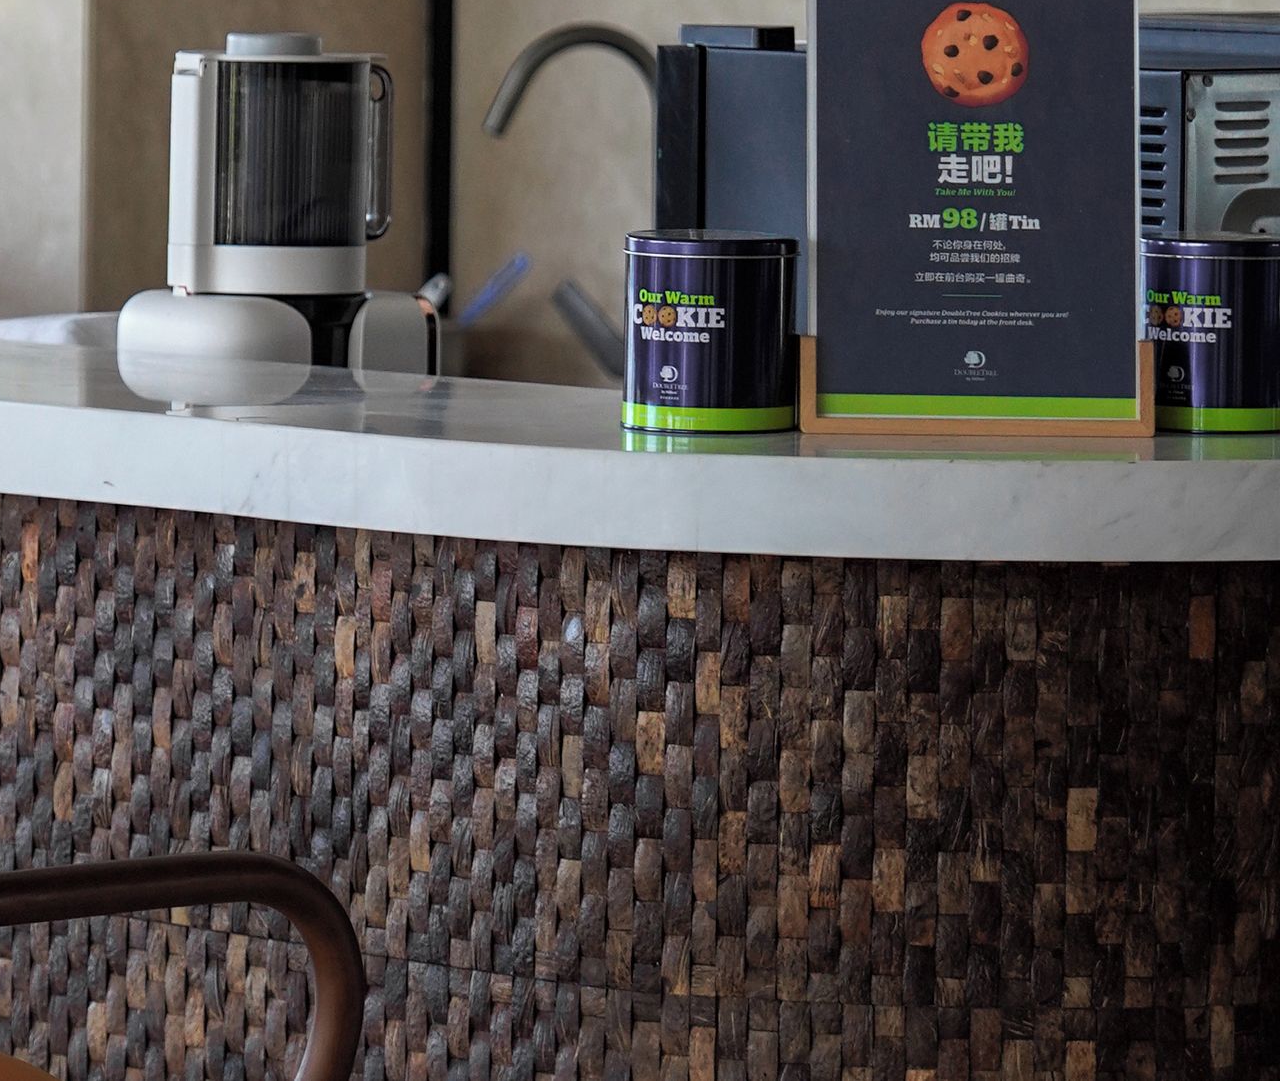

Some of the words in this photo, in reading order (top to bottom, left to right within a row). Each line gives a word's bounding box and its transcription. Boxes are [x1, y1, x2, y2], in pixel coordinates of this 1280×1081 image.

[927, 122, 1025, 153] 请带我
[935, 187, 956, 197] Take
[957, 187, 972, 197] Me
[973, 187, 995, 197] With
[996, 187, 1017, 197] You!
[929, 252, 1021, 264] 均可品尝我们的招牌
[639, 288, 663, 304] Our
[665, 290, 715, 306] Warm
[1146, 289, 1170, 304] Our
[1171, 290, 1222, 306] Warm
[874, 308, 896, 318] Enjoy
[909, 309, 941, 317] signature
[941, 309, 981, 317] DoubleTree
[1009, 310, 1040, 318] wherever
[910, 317, 941, 325] Purchase
[958, 318, 978, 327] today
[999, 319, 1017, 327] front
[640, 326, 710, 343] Welcome
[1147, 327, 1217, 343] Welcome
